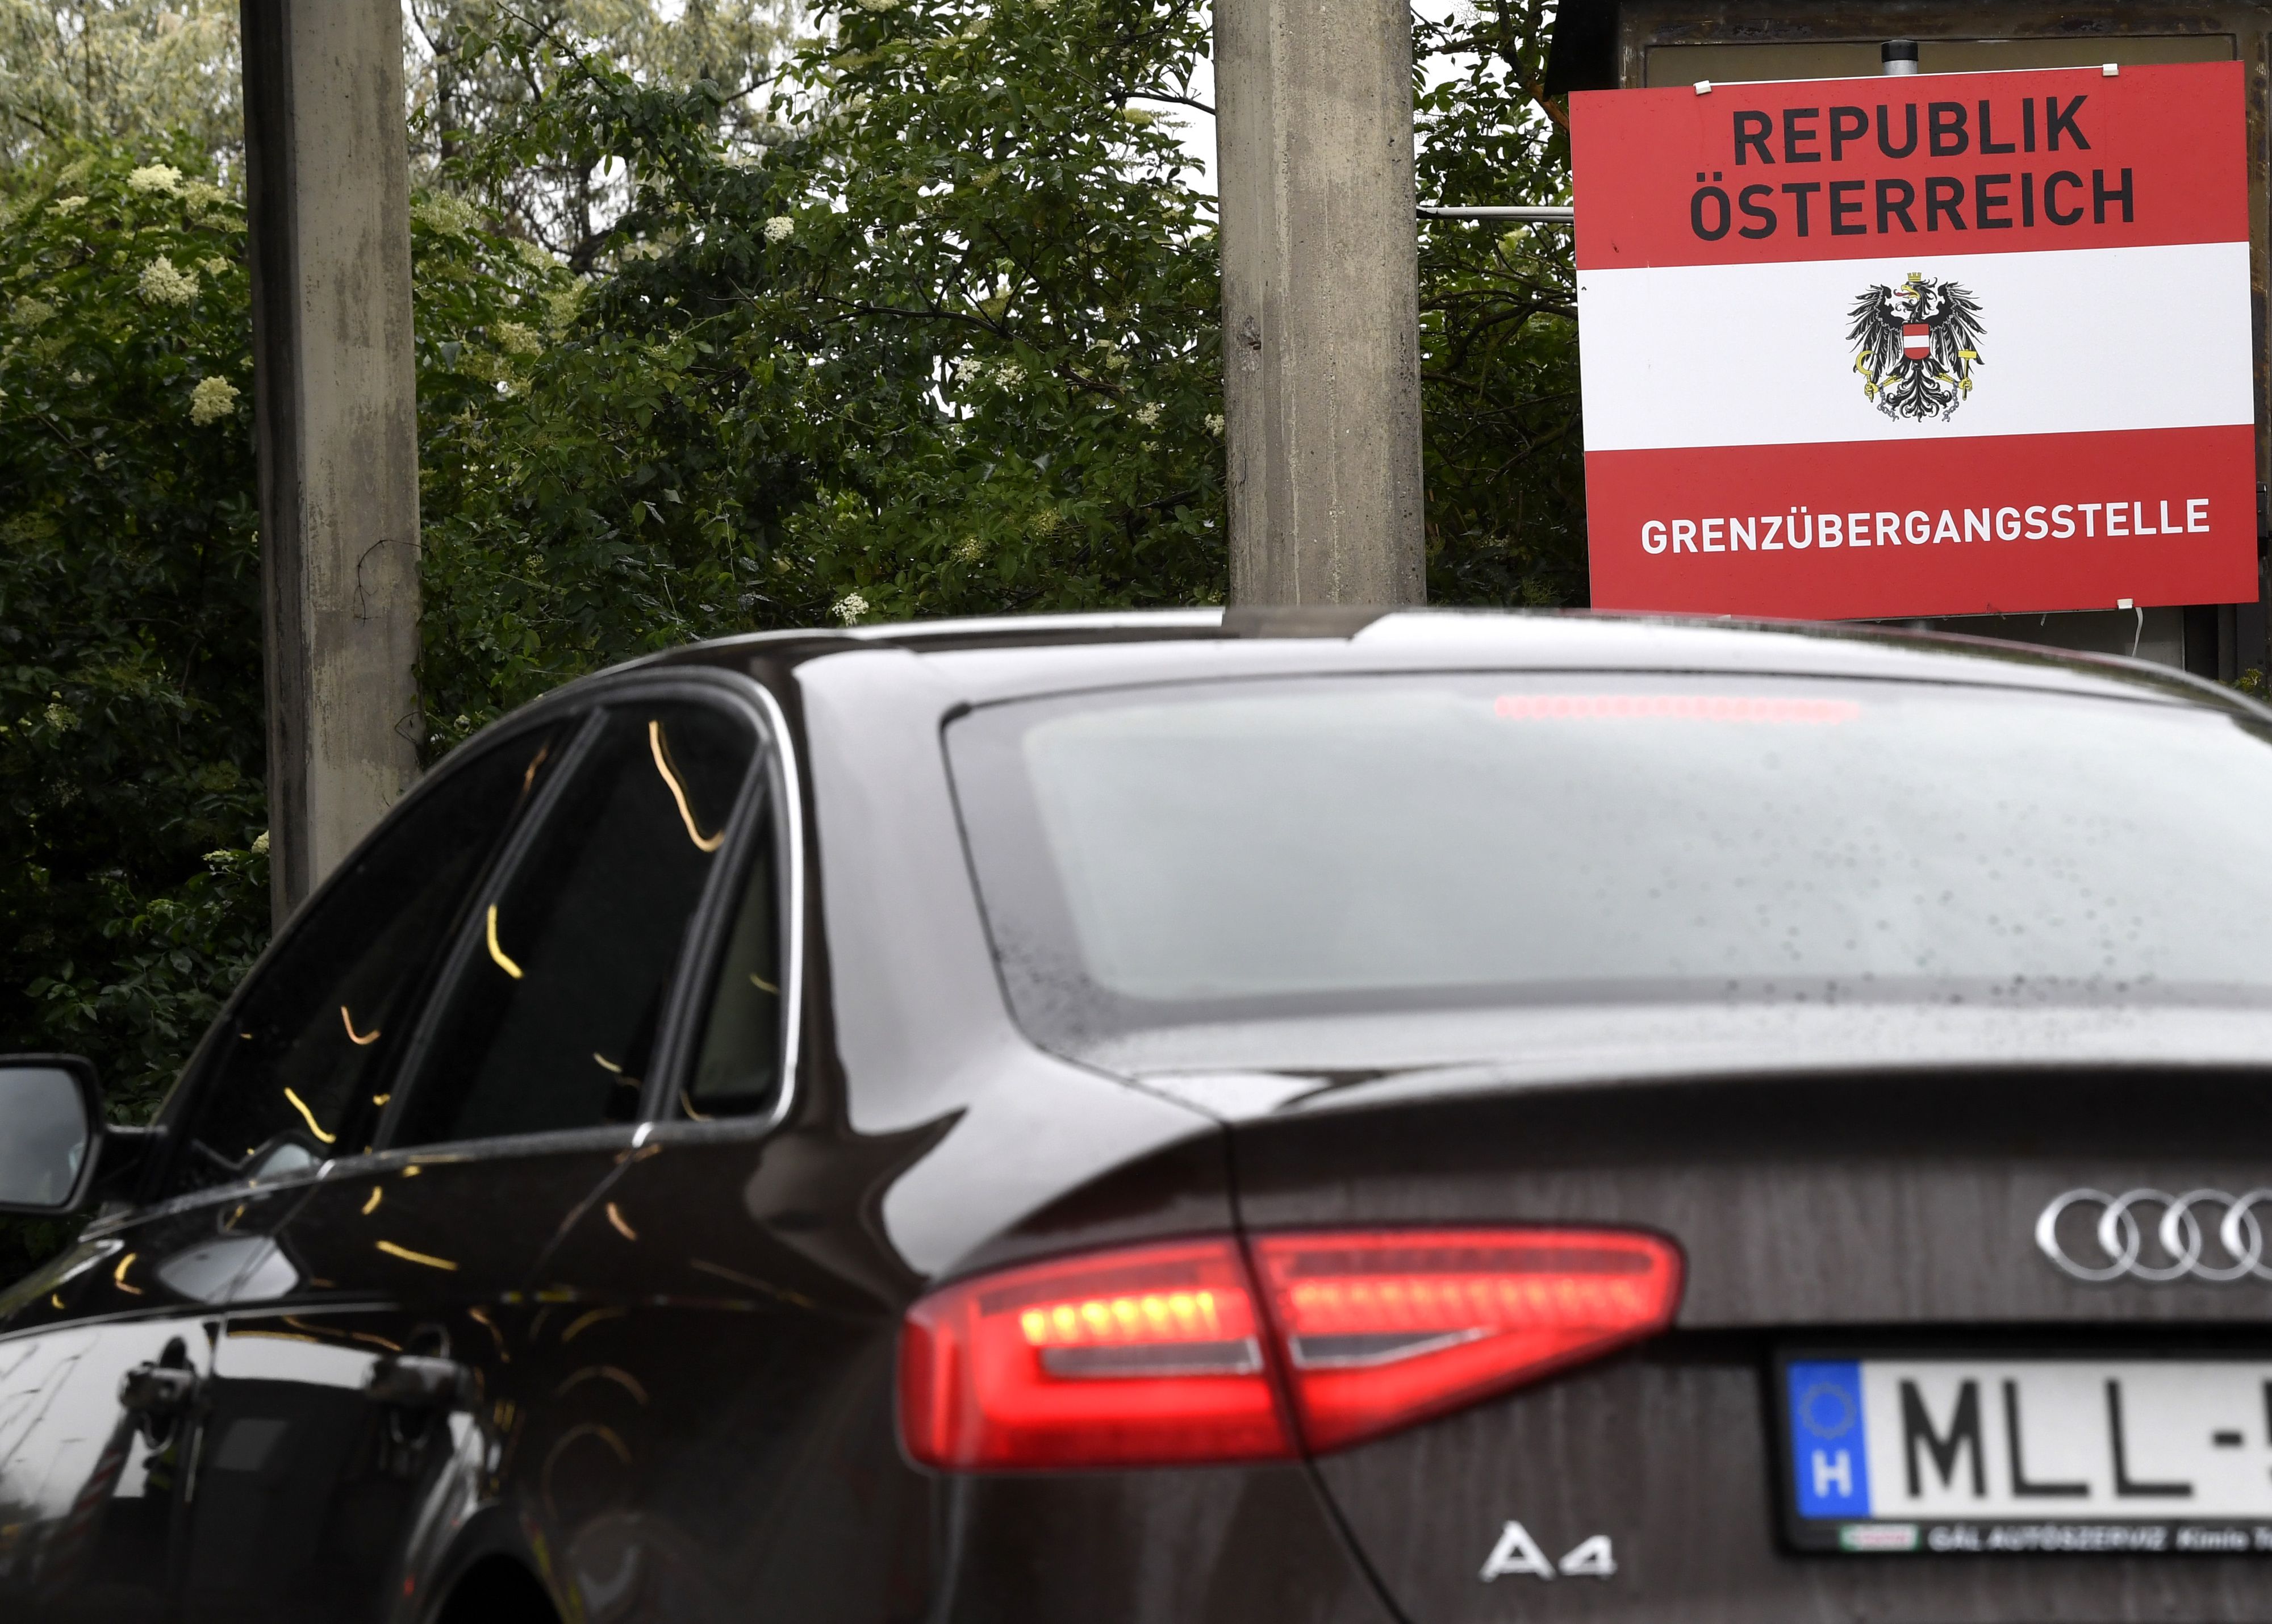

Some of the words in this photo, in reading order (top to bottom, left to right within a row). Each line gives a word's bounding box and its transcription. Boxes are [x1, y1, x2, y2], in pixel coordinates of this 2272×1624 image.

[1734, 95, 2090, 165] REPUBLIK
[1691, 168, 2134, 241] ÖSTERREICH
[1642, 499, 2210, 554] GRENZÜBERGANGSSTELLE
[1898, 1377, 2272, 1498] MLL-
[1812, 1450, 1853, 1497] H
[1480, 1520, 1617, 1581] A4
